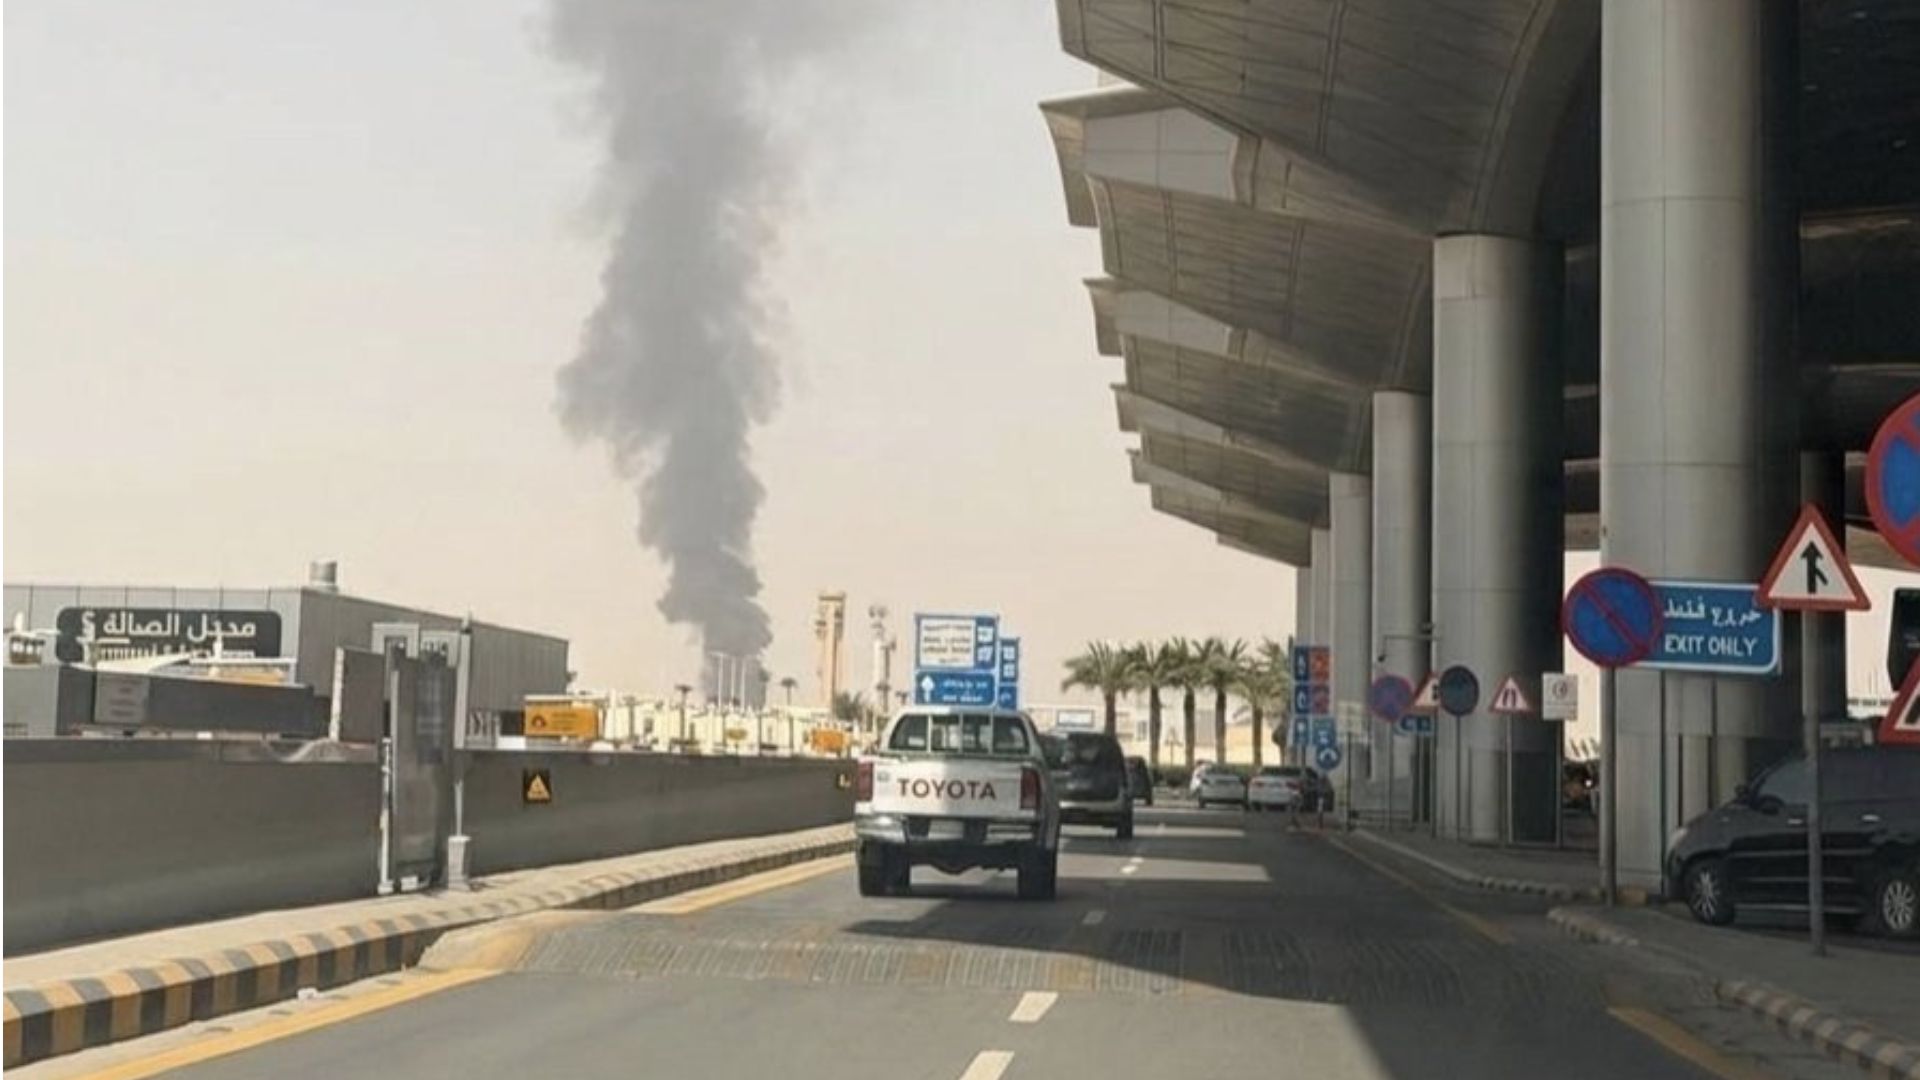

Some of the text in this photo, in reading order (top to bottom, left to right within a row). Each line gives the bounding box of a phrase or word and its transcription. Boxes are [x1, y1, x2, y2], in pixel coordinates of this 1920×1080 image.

[1664, 634, 1758, 657] EXIT ONLY
[899, 779, 996, 800] TOYOTA
